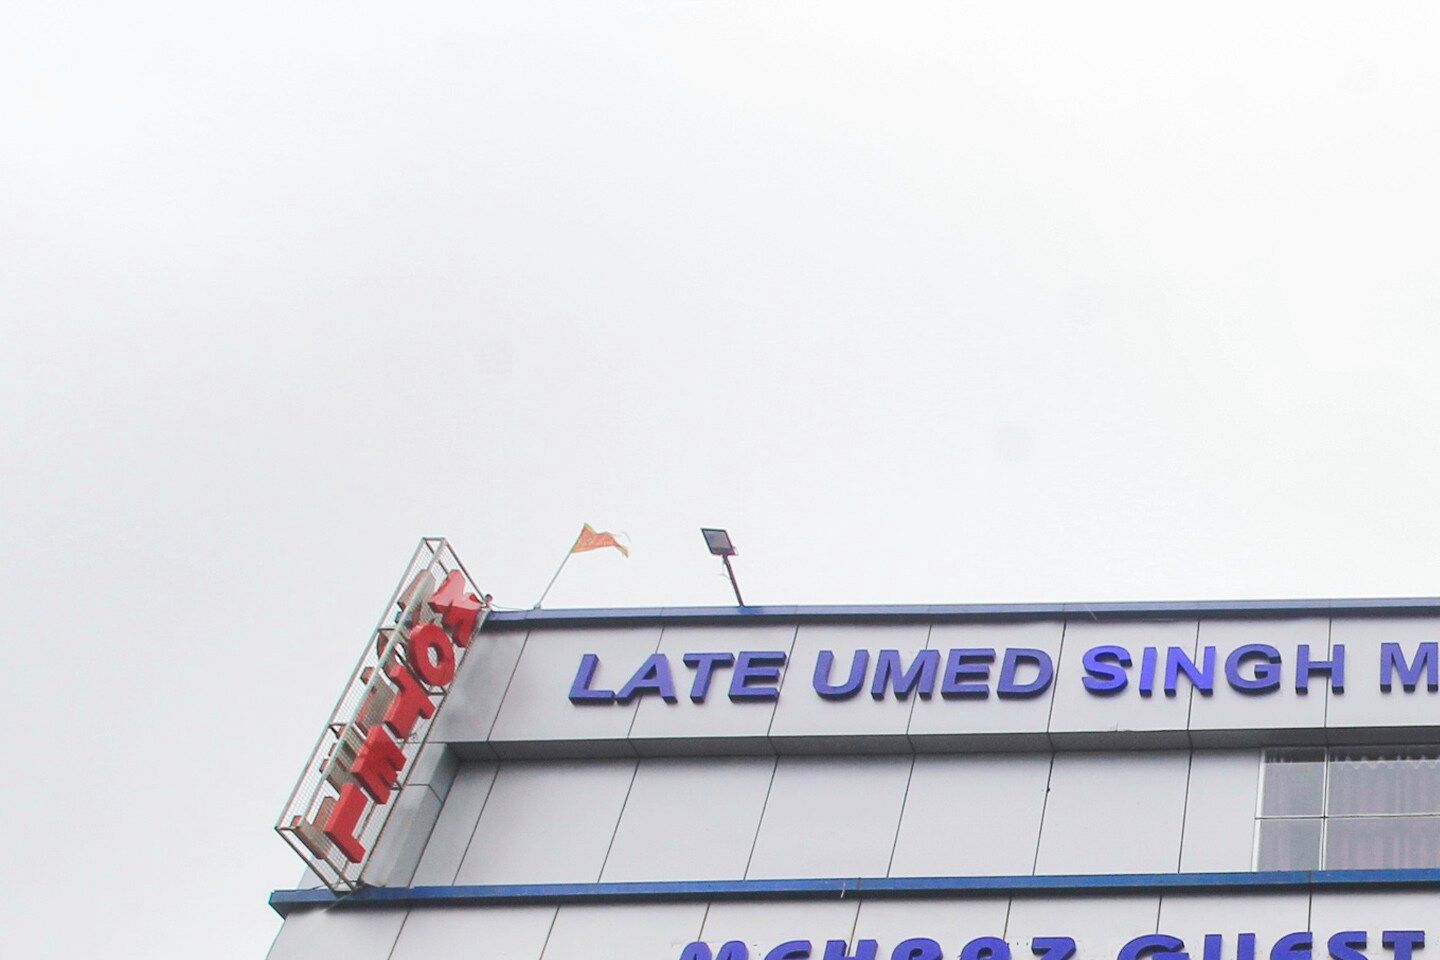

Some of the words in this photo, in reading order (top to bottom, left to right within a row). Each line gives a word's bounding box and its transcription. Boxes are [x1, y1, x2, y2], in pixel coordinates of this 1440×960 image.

[323, 569, 485, 863] HOTEL
[569, 651, 788, 703] LATE
[811, 647, 1054, 701] UMED
[1081, 644, 1346, 698] SINGH
